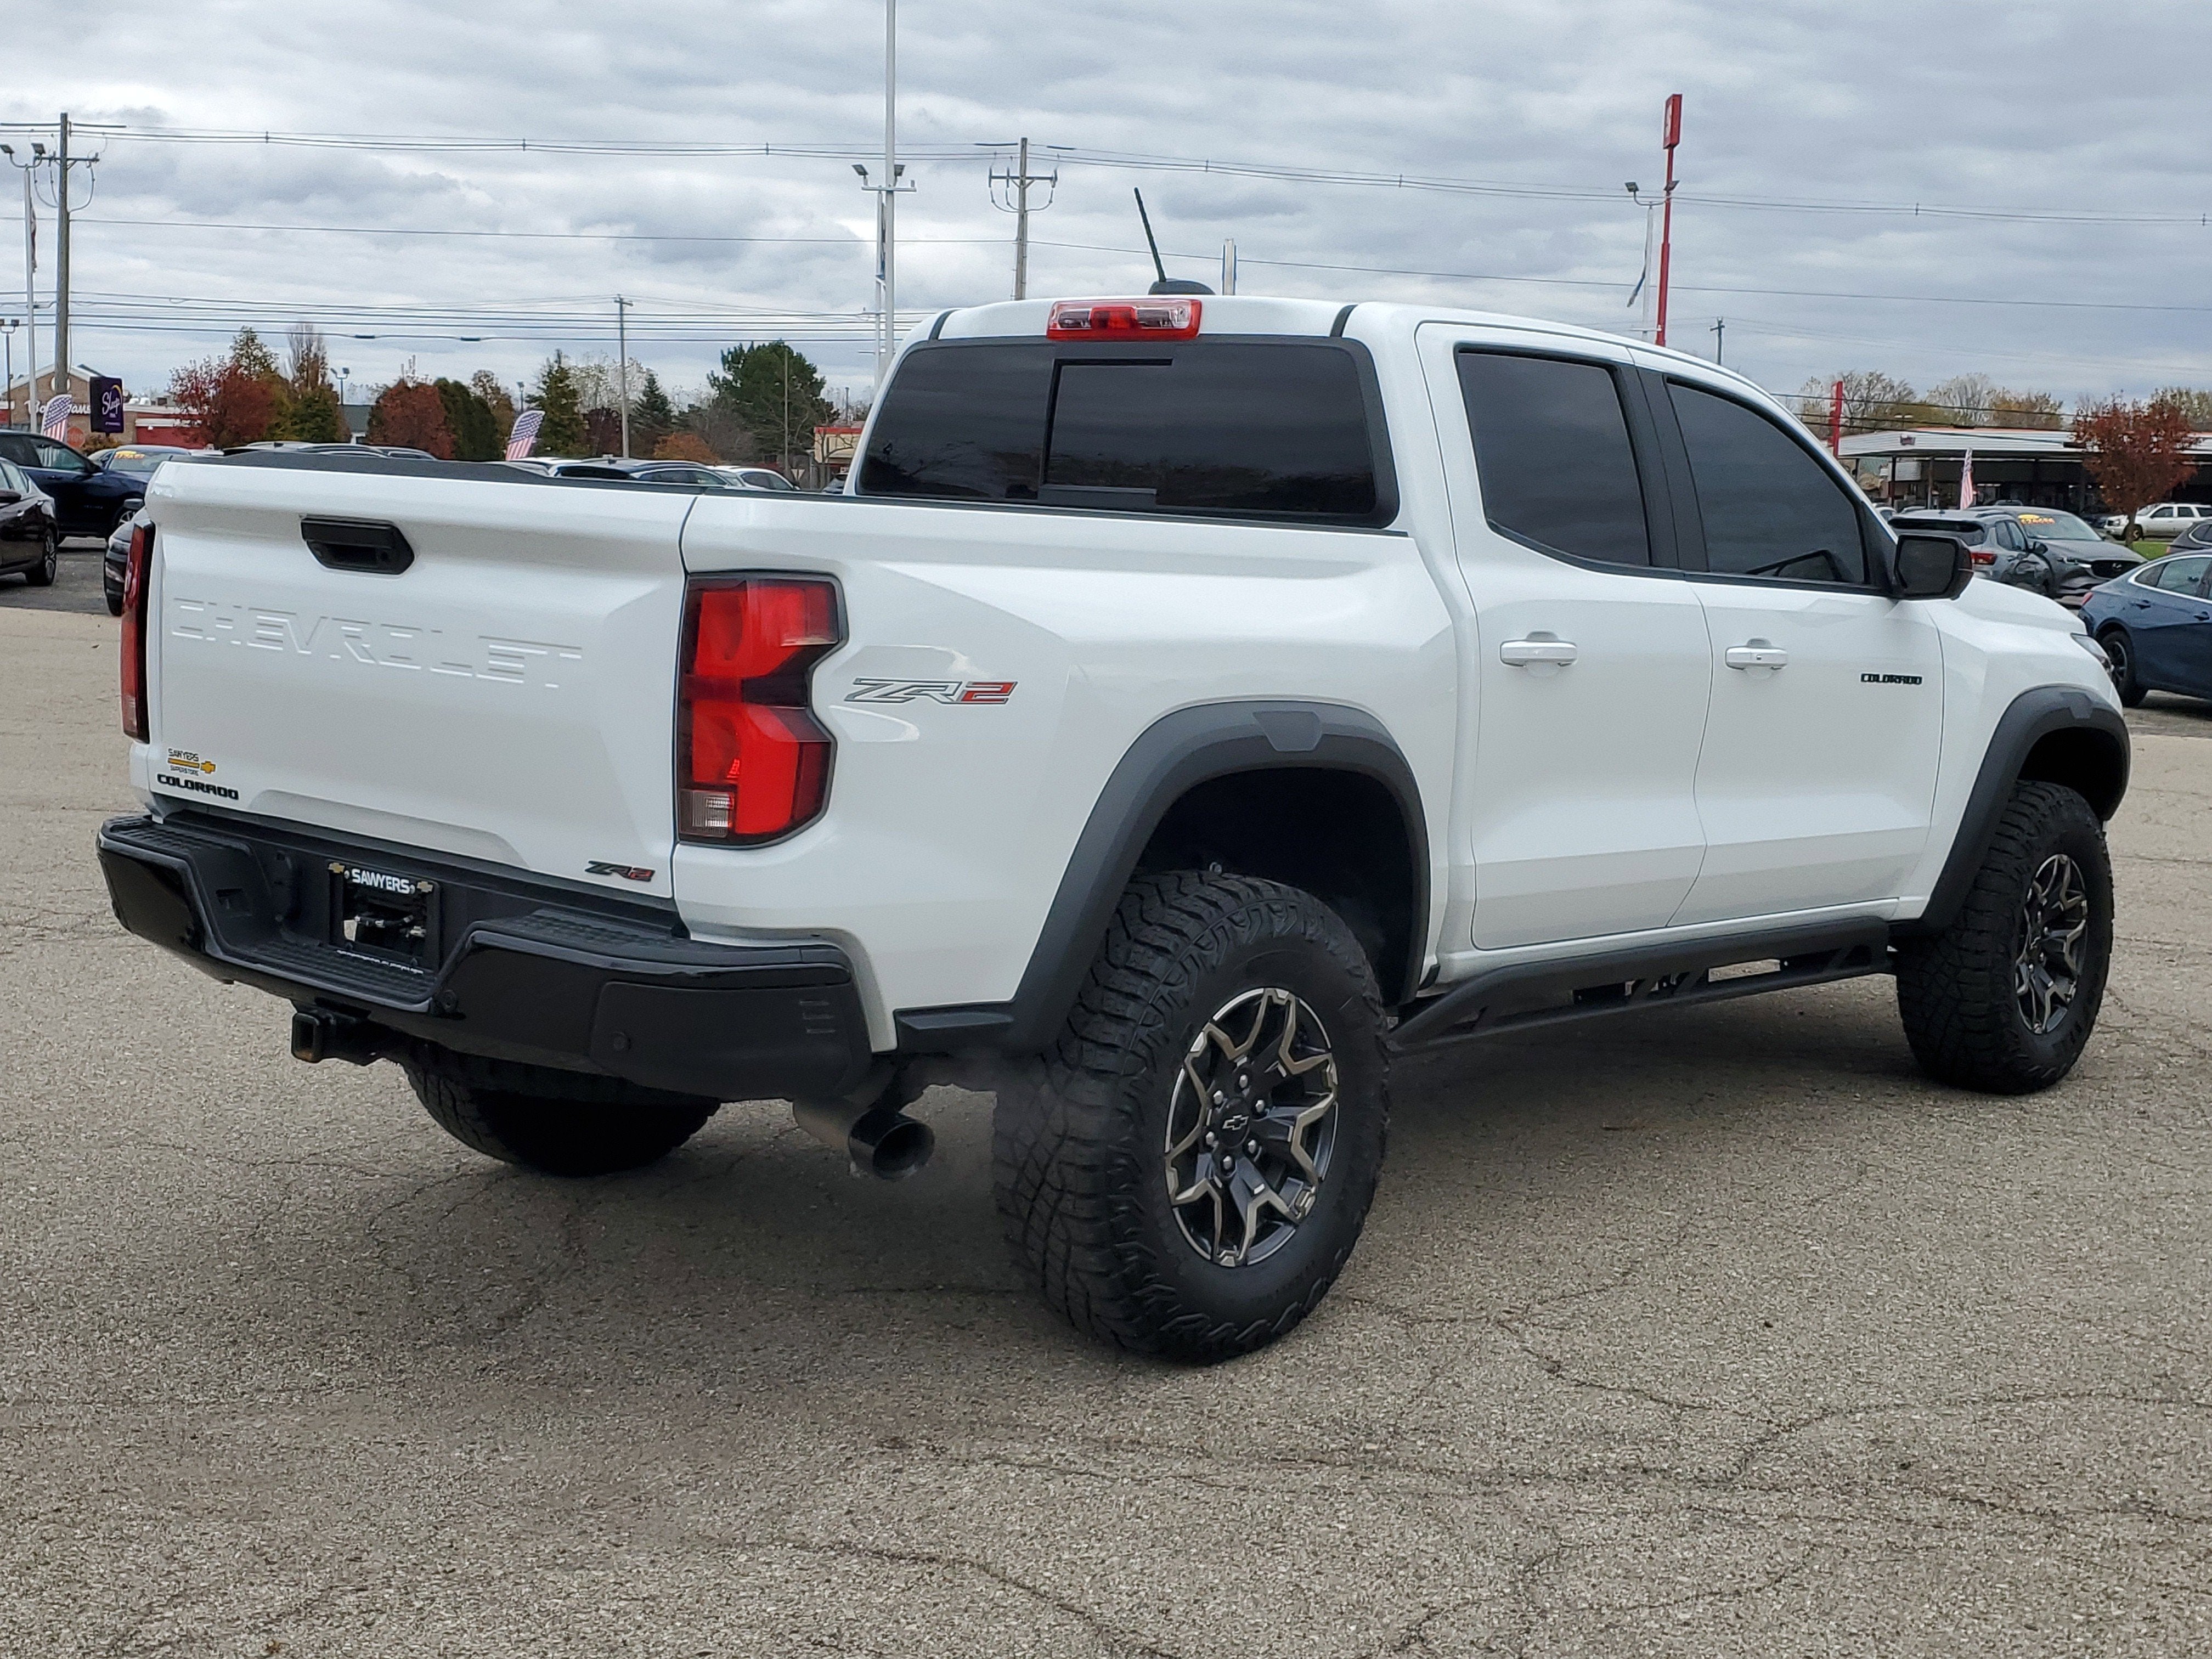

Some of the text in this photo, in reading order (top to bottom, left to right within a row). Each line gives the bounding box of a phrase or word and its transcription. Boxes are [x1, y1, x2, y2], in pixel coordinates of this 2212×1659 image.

[172, 597, 583, 689] CHEVROLET
[844, 678, 1018, 705] ZR2
[1861, 673, 1922, 685] COLORADO
[157, 774, 239, 800] COLORADO
[351, 868, 410, 894] SAWYERS
[584, 860, 656, 882] ZR2
